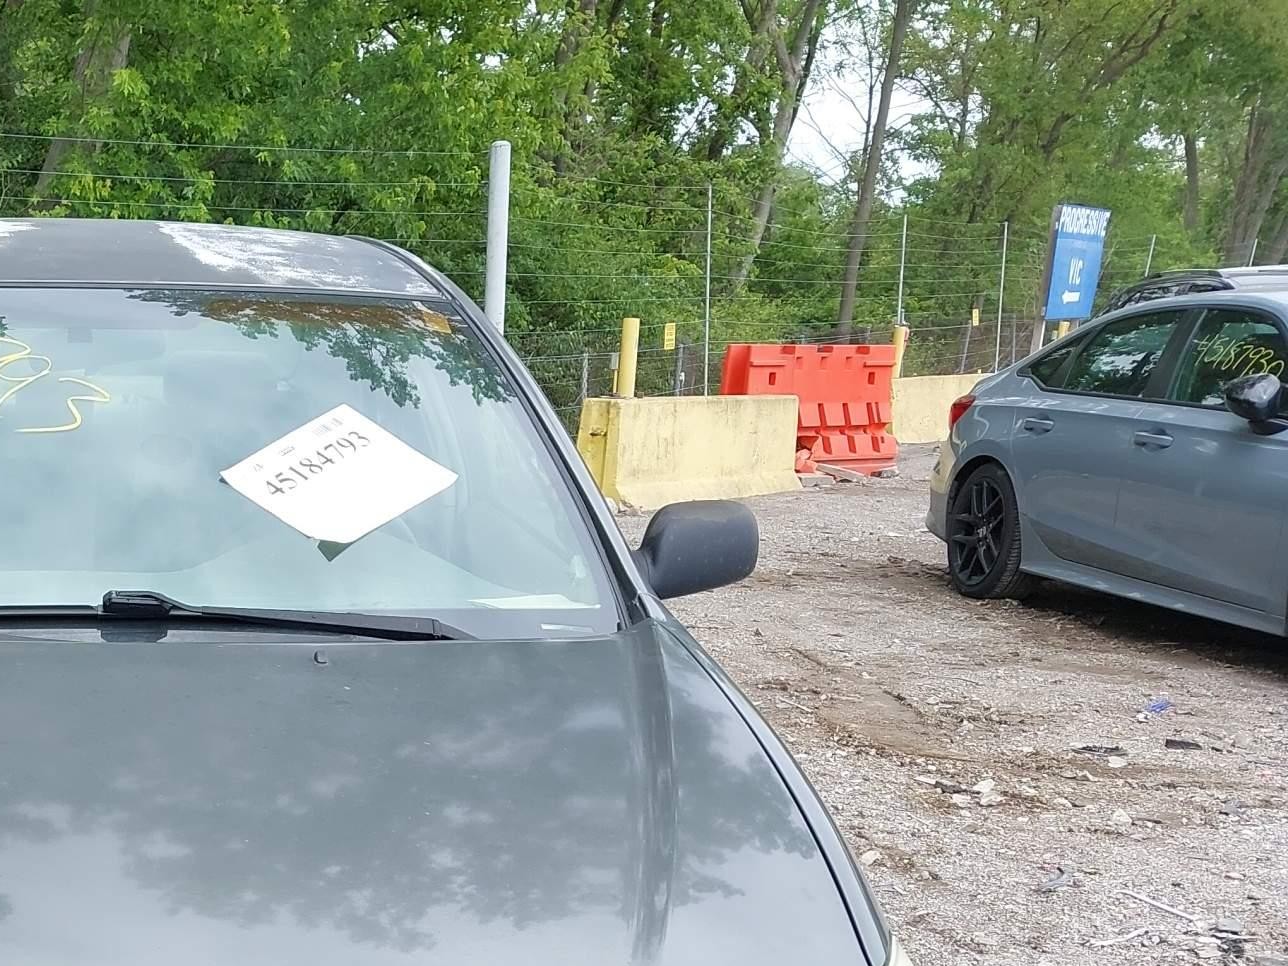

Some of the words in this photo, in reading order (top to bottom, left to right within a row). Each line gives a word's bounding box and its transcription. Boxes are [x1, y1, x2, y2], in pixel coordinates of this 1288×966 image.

[1059, 206, 1111, 237] PROGRESSIVE
[1068, 256, 1085, 285] VIC
[265, 431, 371, 496] 45184793
